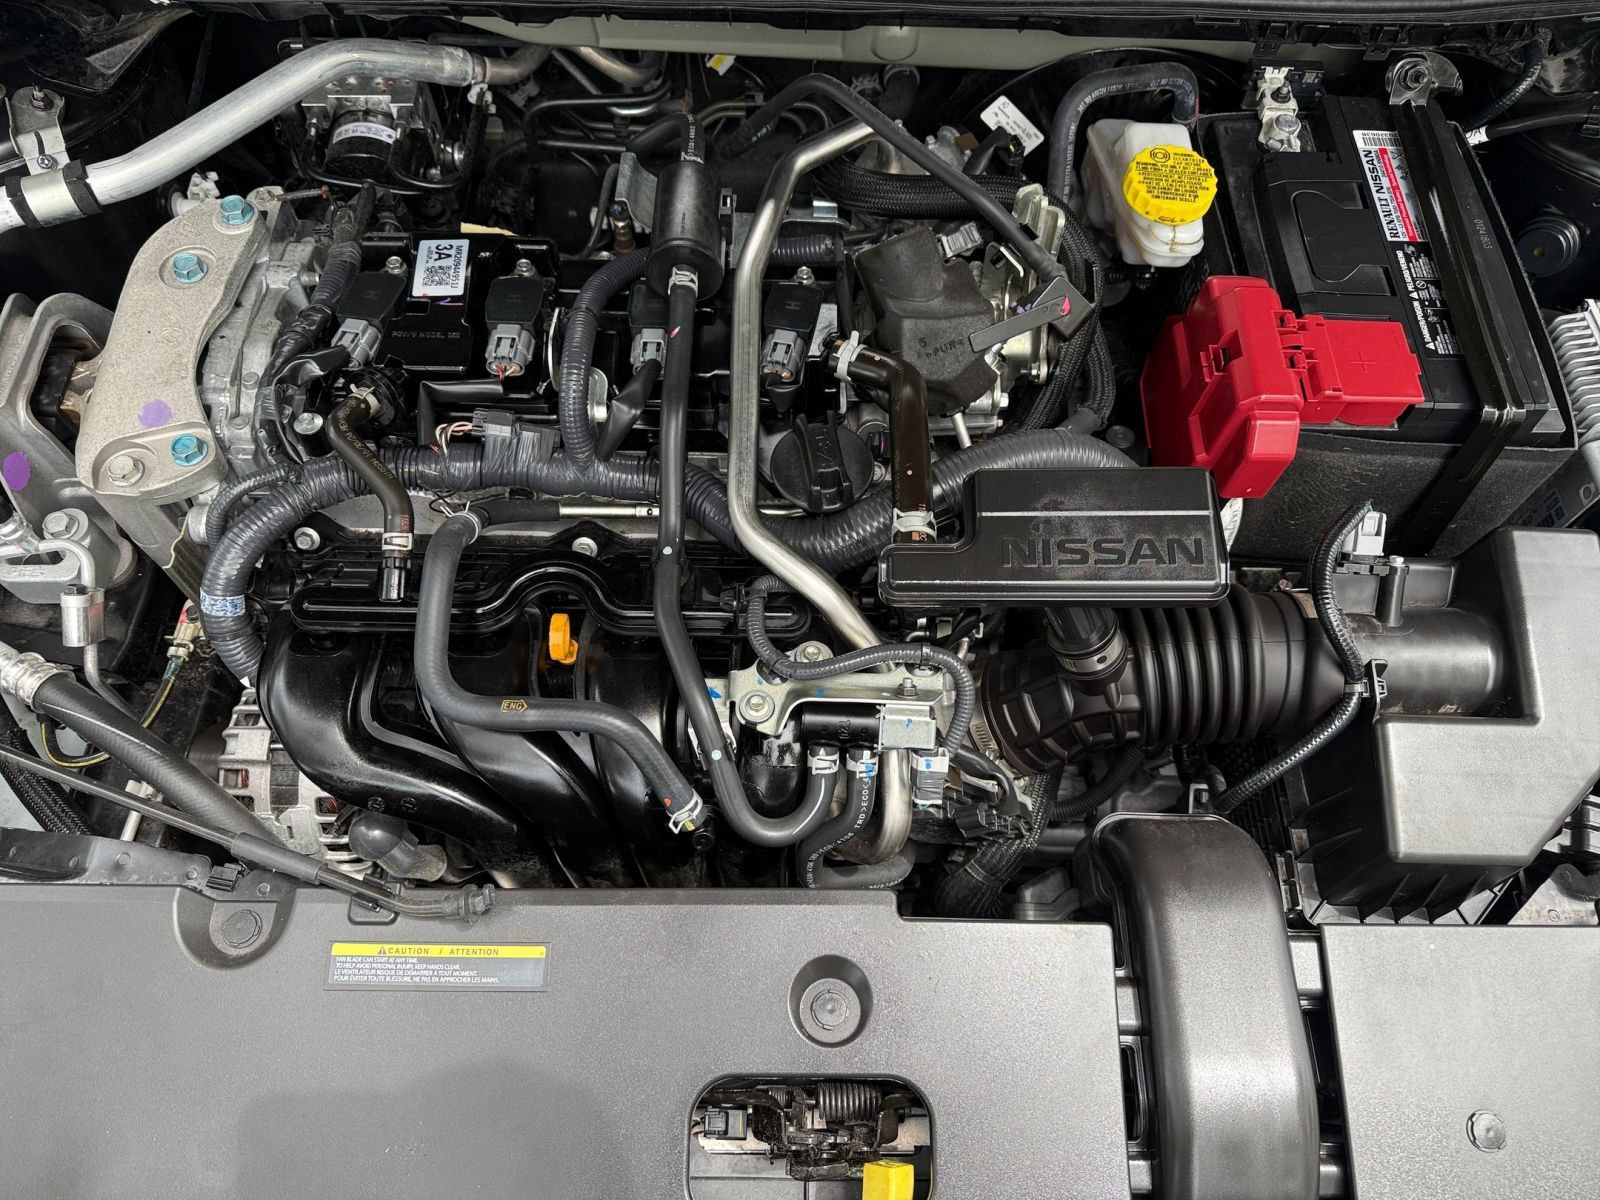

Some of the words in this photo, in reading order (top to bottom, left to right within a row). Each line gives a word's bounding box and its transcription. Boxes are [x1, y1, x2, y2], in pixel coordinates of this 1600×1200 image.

[1362, 150, 1386, 194] NISSAN
[1380, 198, 1400, 239] RENAULT
[434, 244, 454, 262] 3A
[1000, 536, 1205, 568] NISSAN
